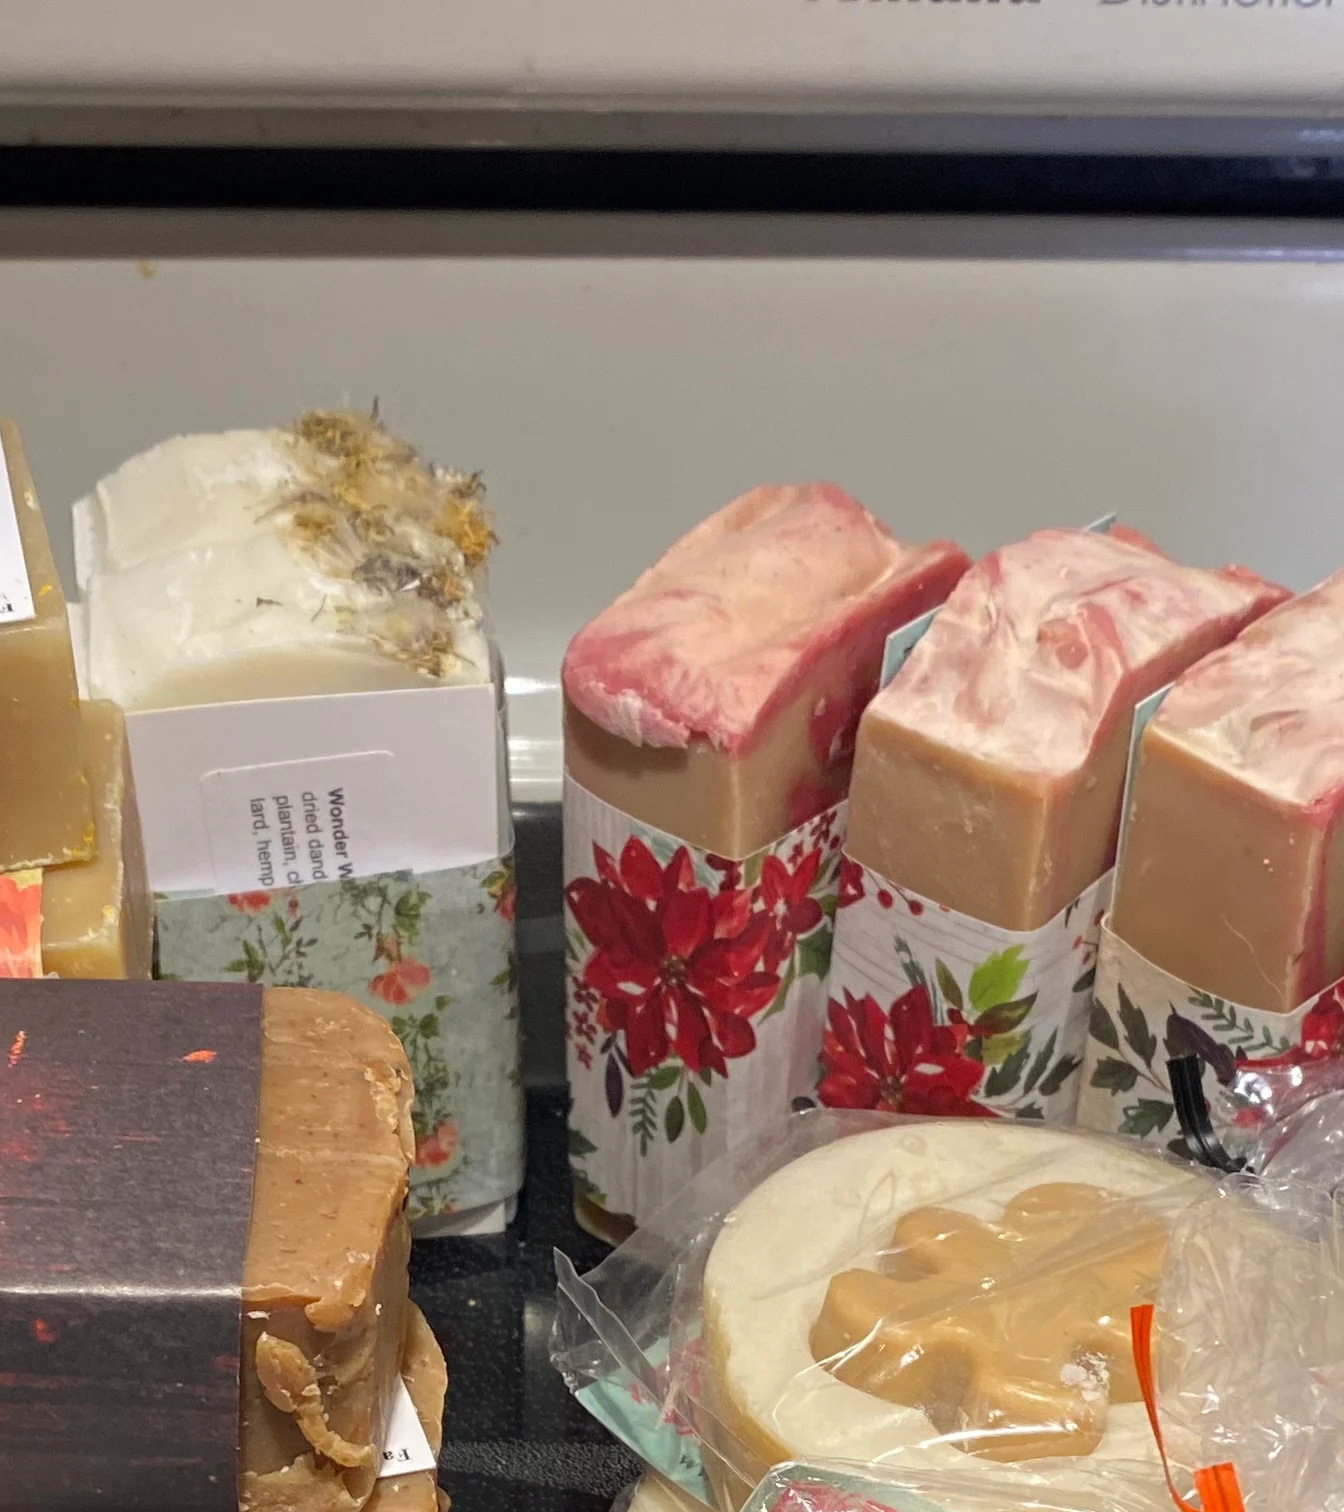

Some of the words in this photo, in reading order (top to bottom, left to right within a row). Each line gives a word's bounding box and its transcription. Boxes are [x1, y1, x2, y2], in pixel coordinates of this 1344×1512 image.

[251, 797, 269, 836] lard,
[272, 795, 300, 866] plantain,
[302, 791, 323, 834] dried
[328, 787, 350, 859] Wonder
[257, 839, 275, 886] hemp
[308, 839, 328, 880] dand
